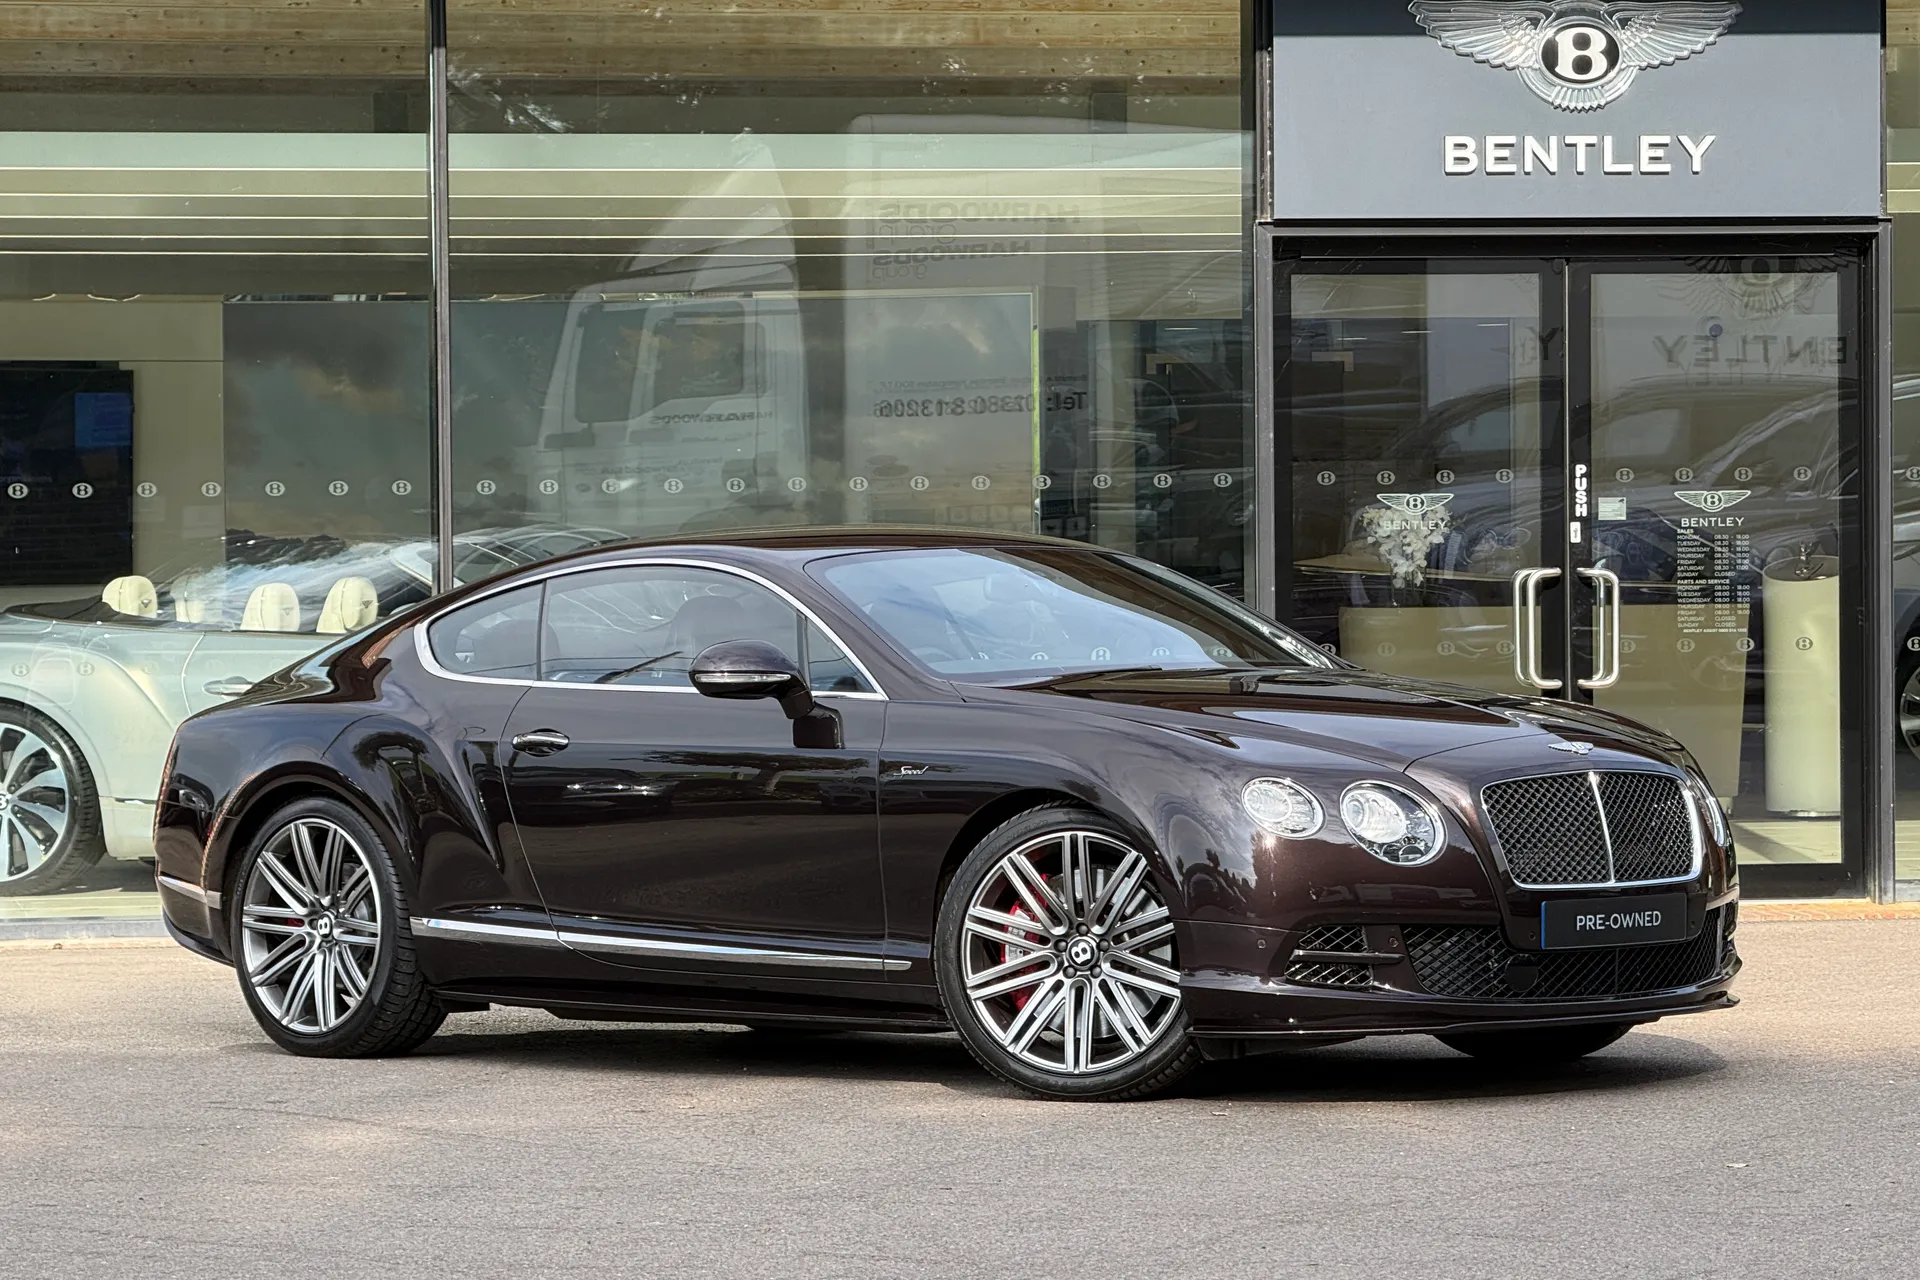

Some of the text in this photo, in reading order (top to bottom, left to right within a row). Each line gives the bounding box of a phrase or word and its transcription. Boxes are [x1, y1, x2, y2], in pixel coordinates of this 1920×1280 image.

[1554, 25, 1609, 81] B
[1444, 134, 1716, 176] BENTLEY
[1575, 464, 1588, 517] PUSH
[1384, 520, 1447, 530] BENTLEY
[1681, 517, 1744, 527] BENTLEY
[1576, 910, 1662, 931] PRE-OWNED
